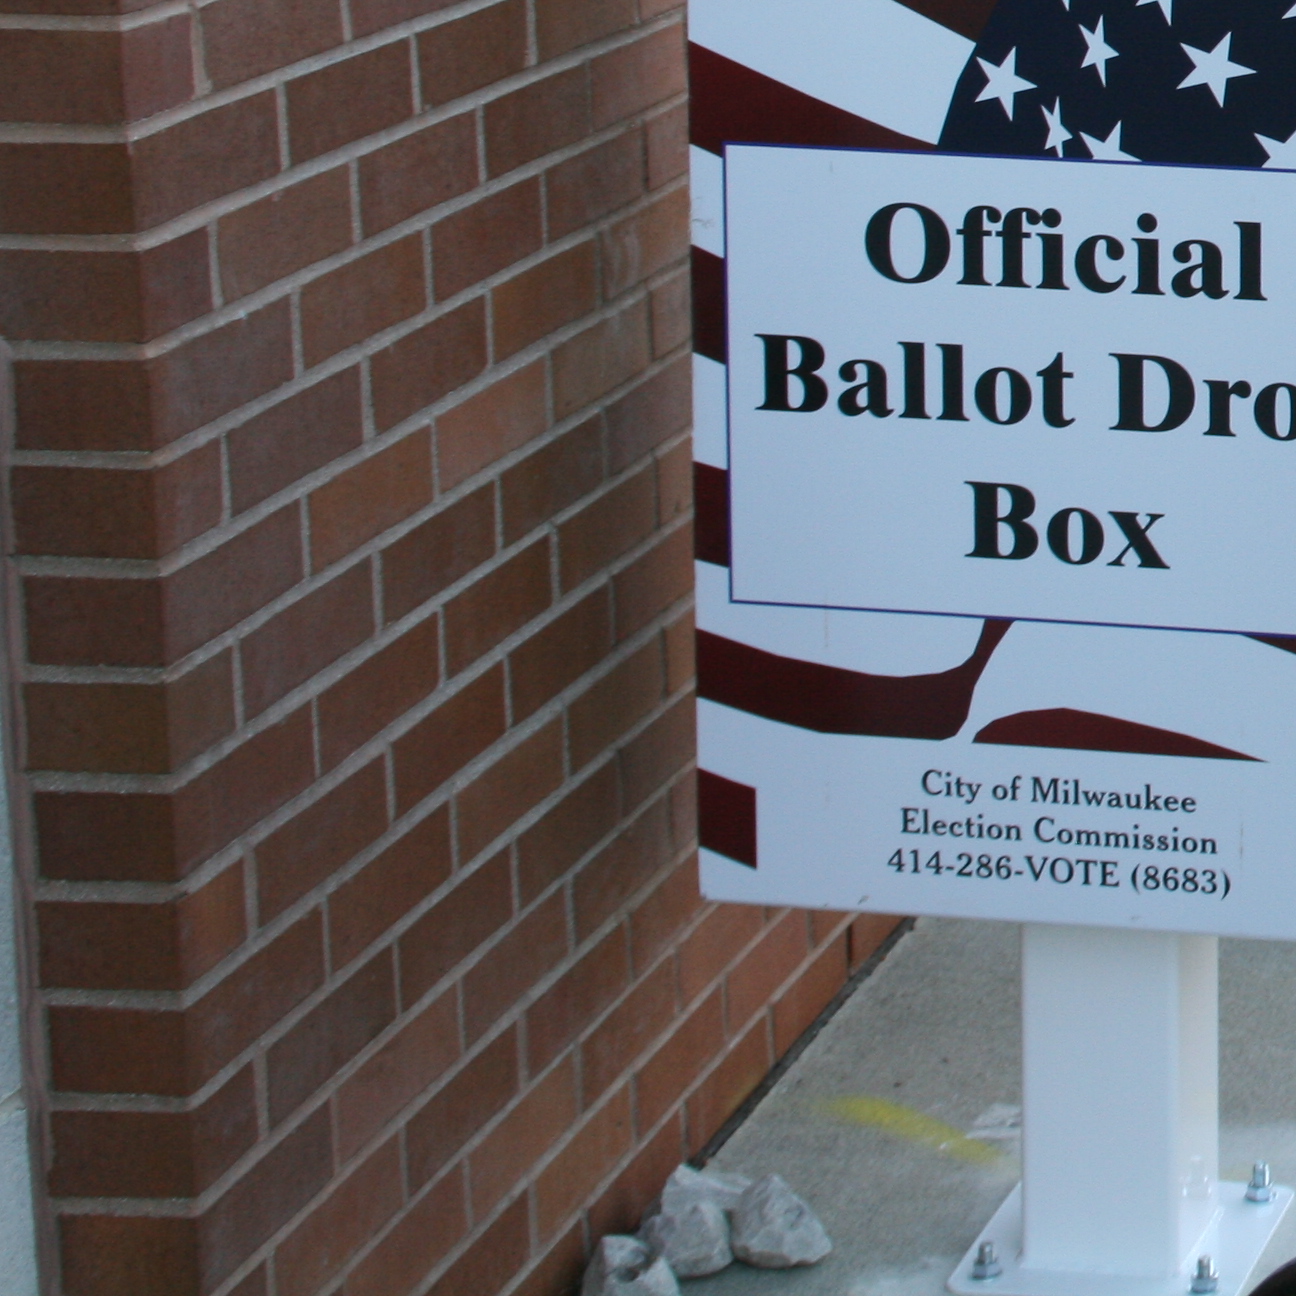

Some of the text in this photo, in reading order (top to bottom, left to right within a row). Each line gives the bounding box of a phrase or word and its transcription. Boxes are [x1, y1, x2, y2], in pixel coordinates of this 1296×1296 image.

[864, 202, 1268, 302] Official
[753, 333, 1076, 429] Ballot
[963, 480, 1171, 570] Box
[921, 769, 1197, 814] City of Milwaukee
[900, 807, 1218, 855] Election Commission
[887, 848, 1231, 900] 414-286-VOTE (8683)
